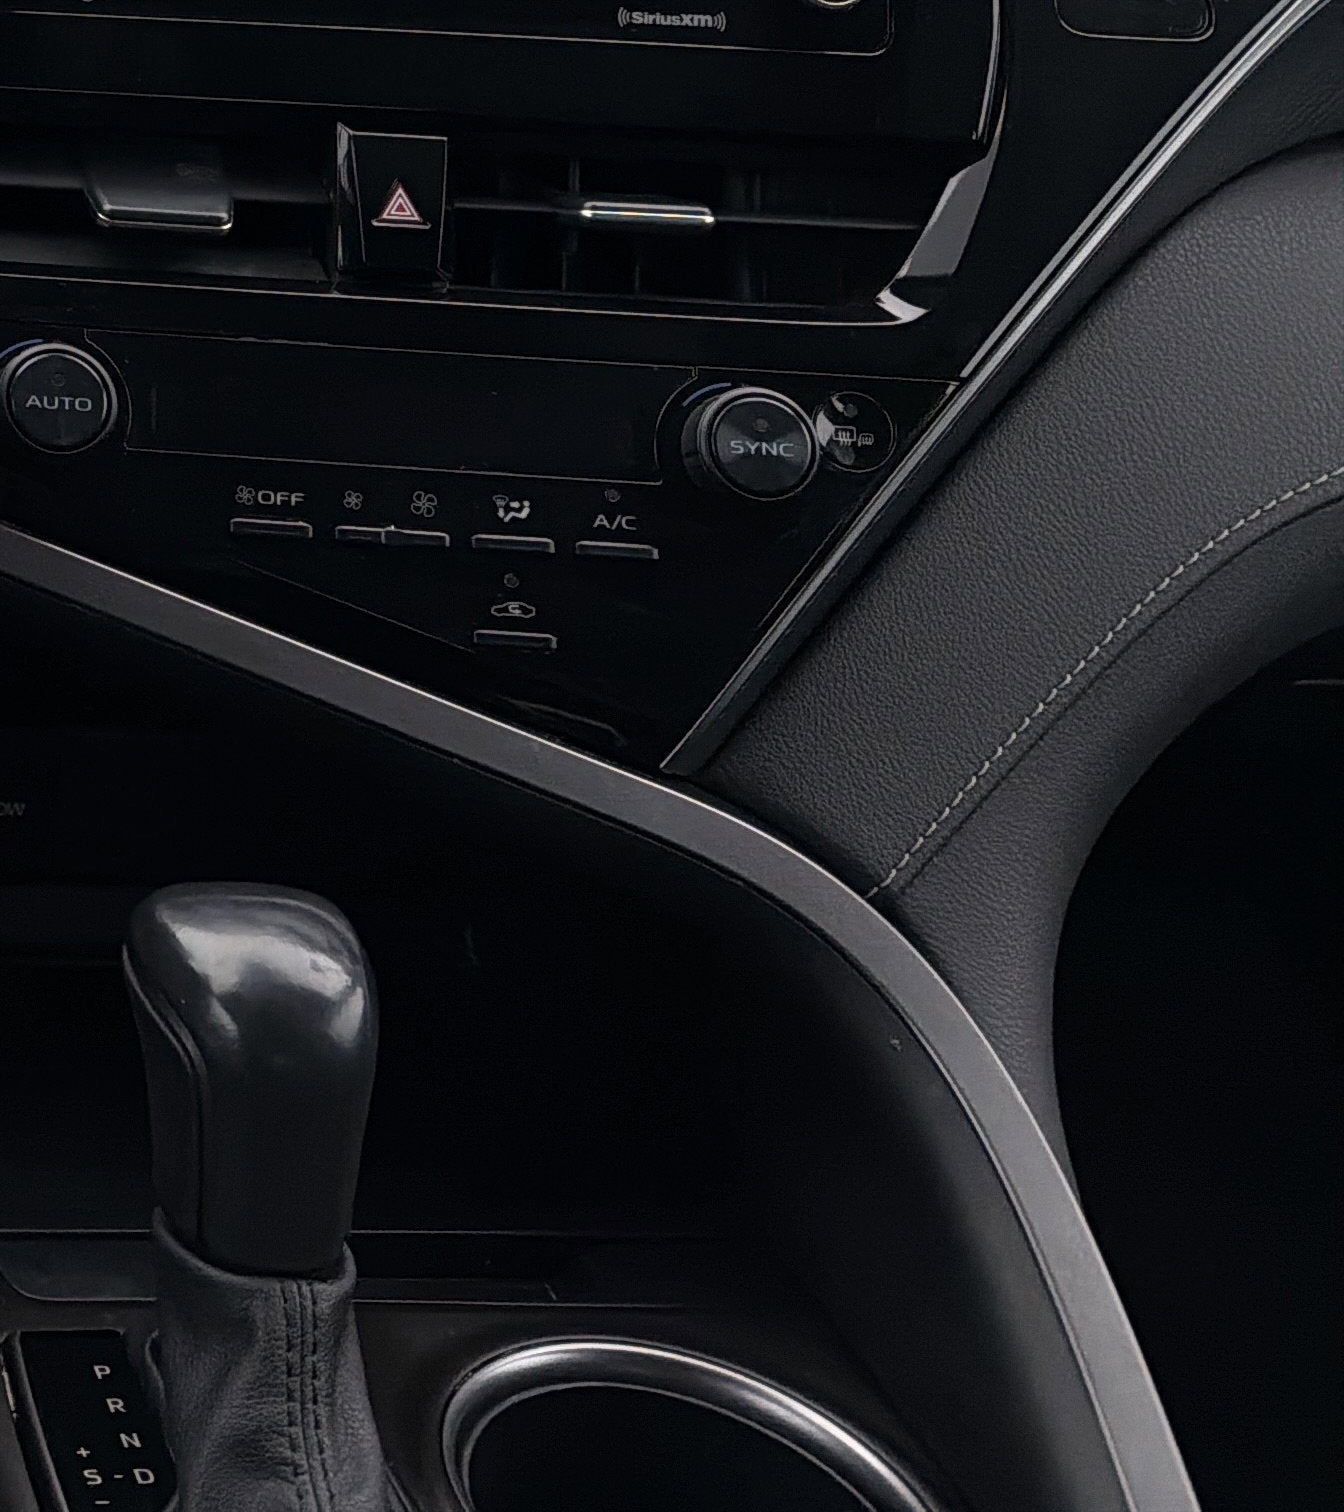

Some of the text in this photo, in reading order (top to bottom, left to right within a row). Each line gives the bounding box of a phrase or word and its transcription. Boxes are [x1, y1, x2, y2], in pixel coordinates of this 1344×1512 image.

[25, 394, 93, 413] AUTO
[729, 439, 795, 459] SYNC
[257, 490, 306, 507] OFF
[592, 513, 638, 532] A/C
[92, 1364, 112, 1380] P
[105, 1396, 128, 1414] R
[118, 1432, 143, 1449] N
[81, 1468, 104, 1487] S
[132, 1467, 156, 1485] D
